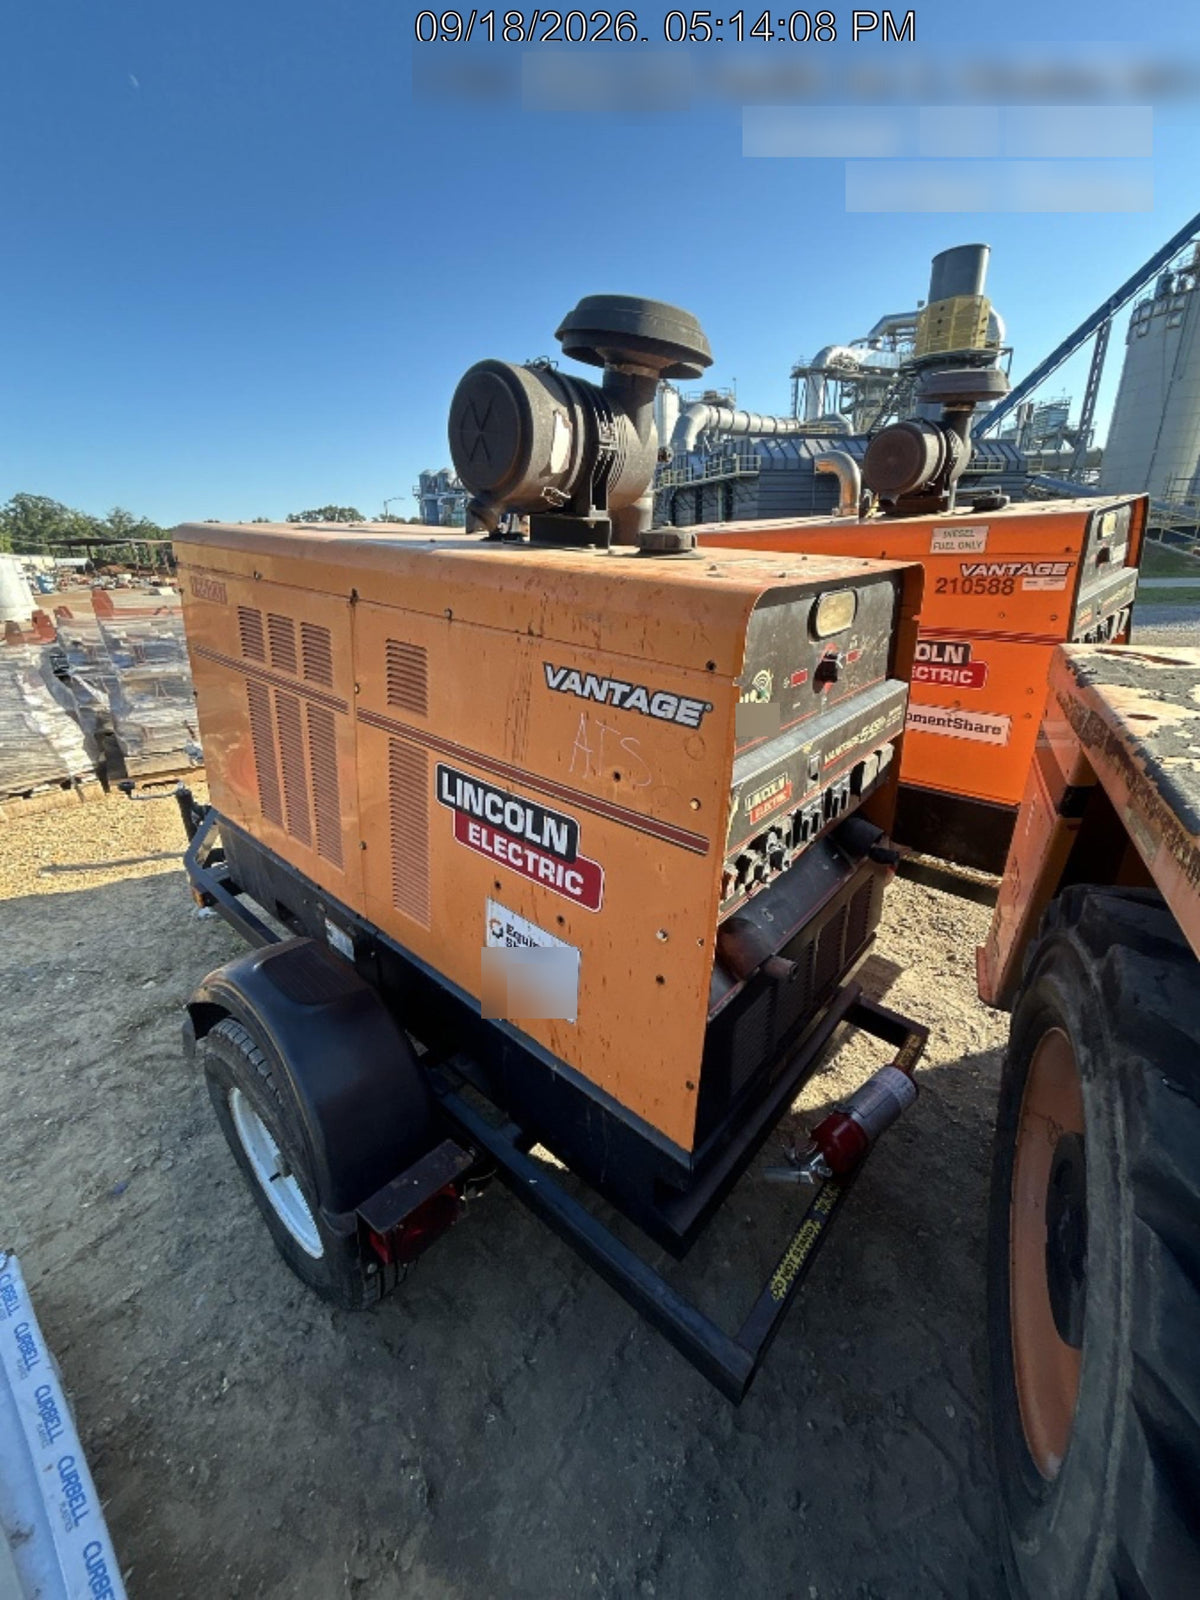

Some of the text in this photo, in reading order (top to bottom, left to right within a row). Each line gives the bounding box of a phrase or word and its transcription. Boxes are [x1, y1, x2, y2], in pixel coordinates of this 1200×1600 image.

[934, 541, 983, 550] FUEL ONLY
[961, 562, 1069, 577] VANTAGE
[935, 577, 1015, 596] 210588
[543, 662, 706, 729] VANTAGE
[568, 712, 652, 787] ATS
[442, 772, 568, 856] LINCOLN
[468, 821, 584, 895] ELECTRIC
[14, 1322, 41, 1372] CURBELL
[35, 1385, 64, 1444] CURBELL
[57, 1455, 90, 1528] CURBELL
